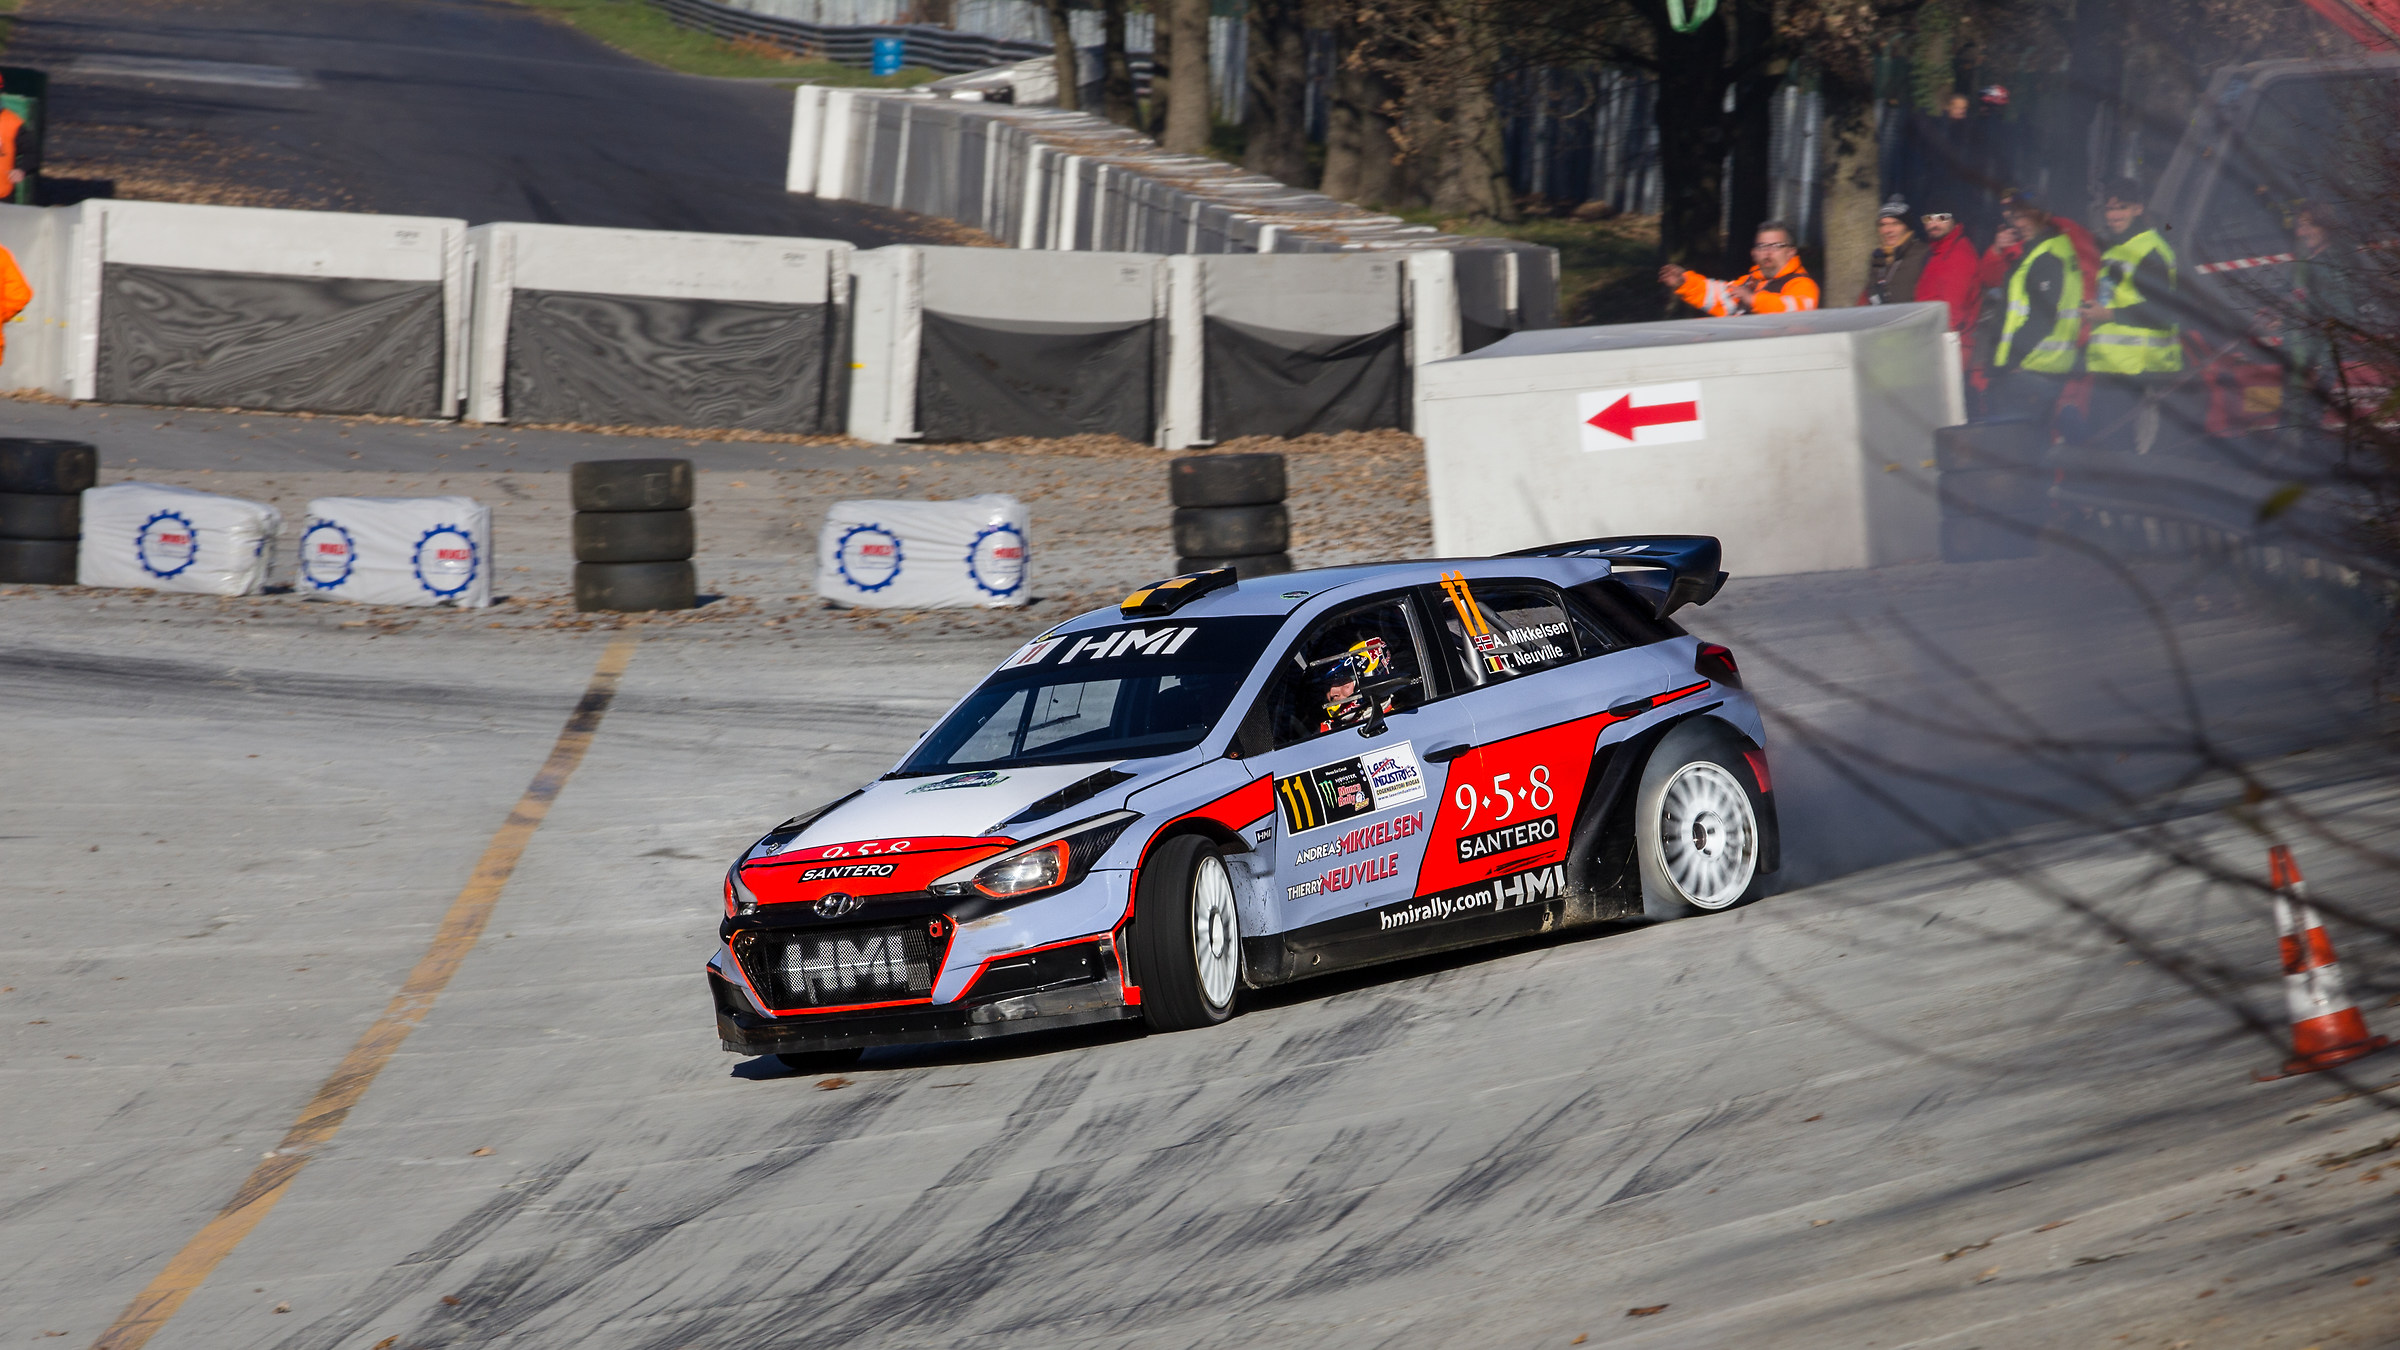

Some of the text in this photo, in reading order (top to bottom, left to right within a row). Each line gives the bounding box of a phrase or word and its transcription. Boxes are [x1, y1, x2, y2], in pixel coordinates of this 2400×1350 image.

[1440, 570, 1490, 637] 11
[1057, 627, 1198, 665] HMI
[1492, 621, 1569, 649] A. Mikkelsen
[1500, 643, 1563, 669] T. Neuville
[1281, 775, 1315, 830] 11
[1295, 810, 1423, 866] ANDREAS MIKKELSEN
[1460, 819, 1556, 859] SANTERO
[802, 864, 893, 881] SANTERO
[1287, 852, 1399, 901] THIERRY NEUVILLE
[1380, 864, 1566, 931] hmirally.com HMI
[786, 935, 909, 994] HMI
